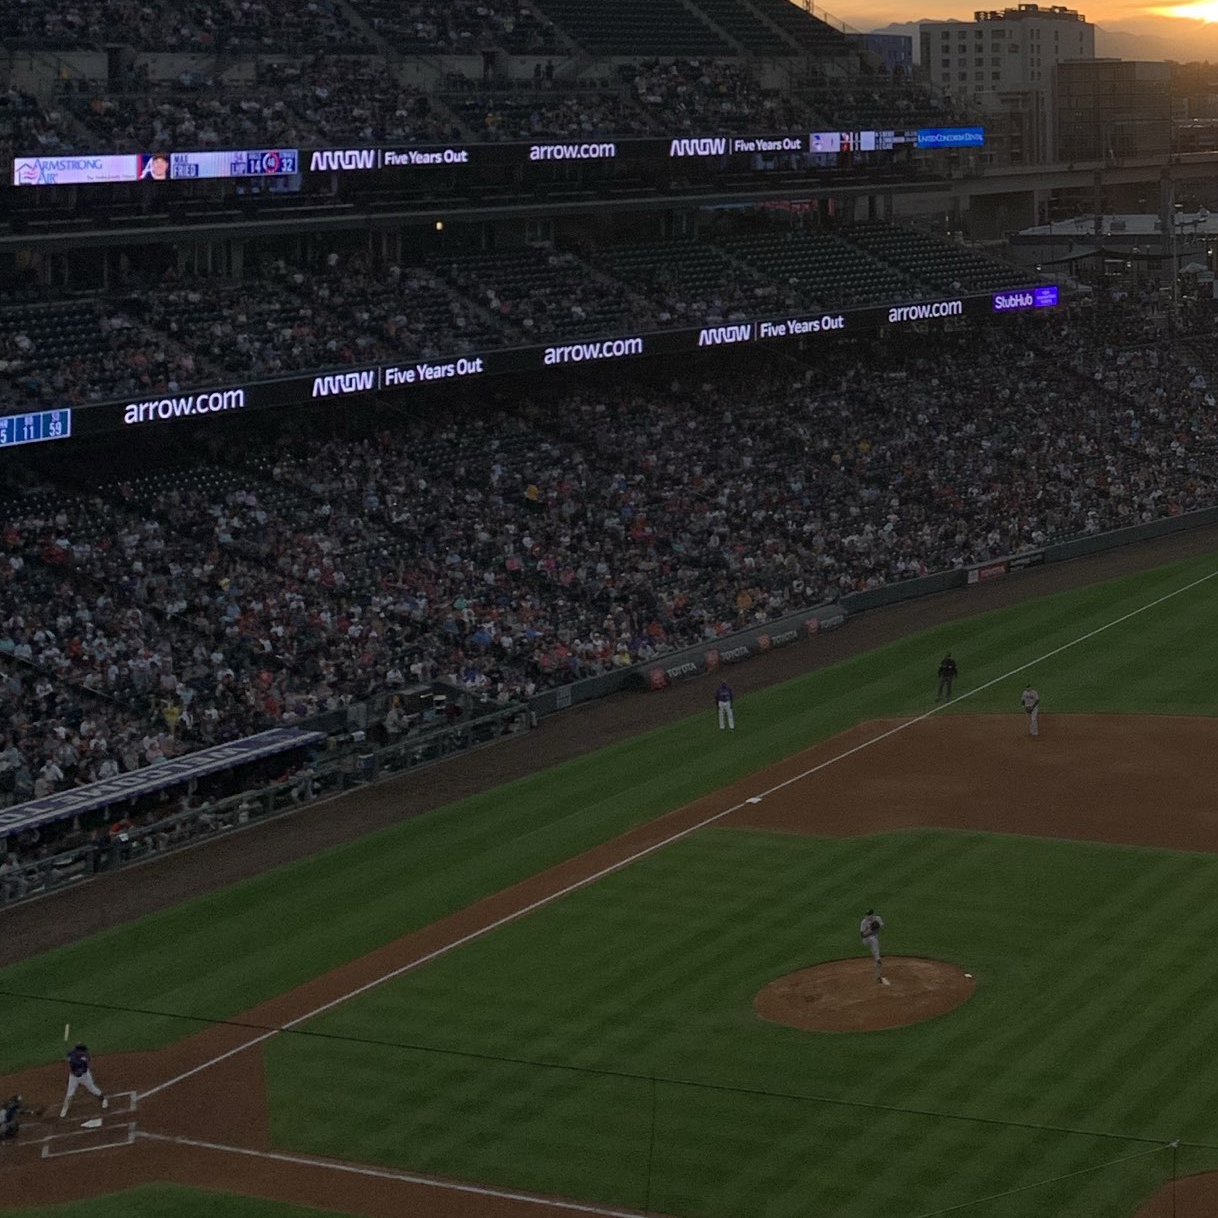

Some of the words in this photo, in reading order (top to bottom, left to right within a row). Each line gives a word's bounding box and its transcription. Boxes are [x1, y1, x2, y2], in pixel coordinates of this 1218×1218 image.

[310, 150, 374, 171] ARROW
[384, 152, 407, 166] Five
[409, 151, 442, 165] Years
[444, 150, 468, 163] Out
[530, 142, 616, 161] arrow.com
[670, 138, 726, 156] ARROW
[734, 139, 755, 152] Five
[756, 139, 782, 151] Years
[783, 138, 802, 150] Out
[33, 159, 103, 171] ARMSTRONG
[173, 164, 197, 177] FRIED
[250, 161, 261, 173] 14
[282, 159, 293, 172] 32
[888, 300, 962, 323] arrow.com
[995, 293, 1033, 309] StubHub
[699, 325, 751, 346] ARROW
[760, 321, 785, 338] Five
[787, 318, 820, 335] Years
[822, 315, 844, 331] Out
[543, 337, 643, 365] arrow.com
[312, 371, 374, 398] ARROW
[385, 369, 415, 386] Five
[416, 363, 455, 382] Years
[457, 358, 483, 376] Out
[124, 389, 244, 424] arrow.com
[23, 425, 34, 440] 11
[49, 422, 62, 437] 59
[720, 646, 749, 662] TOYOTA
[666, 662, 697, 679] TOYOTA
